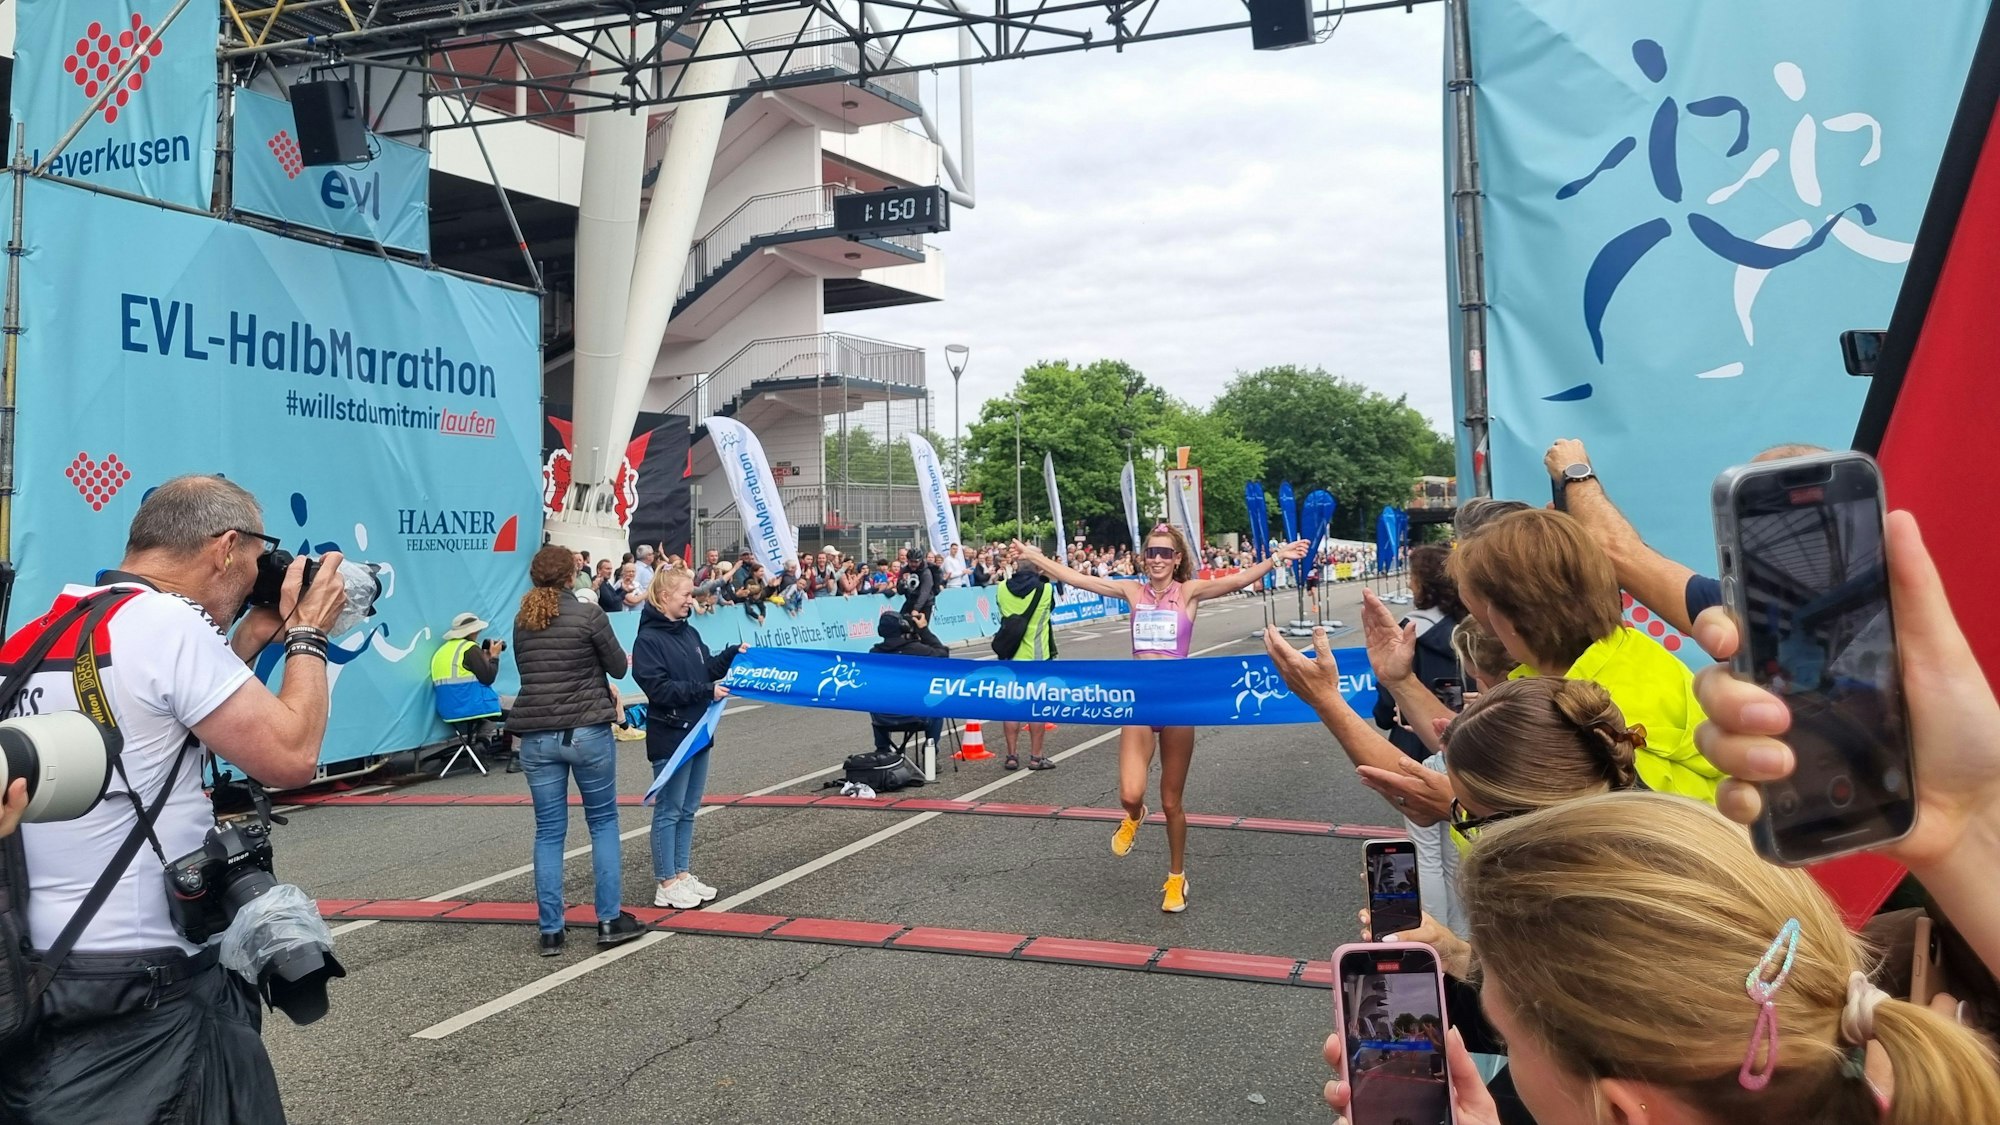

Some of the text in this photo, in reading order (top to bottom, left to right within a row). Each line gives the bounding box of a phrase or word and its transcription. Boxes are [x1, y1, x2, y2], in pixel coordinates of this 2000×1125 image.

[321, 170, 380, 221] evl
[865, 197, 931, 222] 1:15:01
[121, 293, 496, 398] EVL-HalbMarathon
[398, 509, 496, 535] HAANER
[407, 538, 488, 552] FELSENQUELLE
[754, 629, 771, 648] Auf
[775, 628, 792, 647] die
[76, 653, 105, 724] Nikon D850
[722, 676, 792, 693] everkusen
[929, 677, 1136, 703] EVL-HalbMarathon
[1031, 703, 1134, 719] Leverkusen
[228, 851, 250, 865] Nikon
